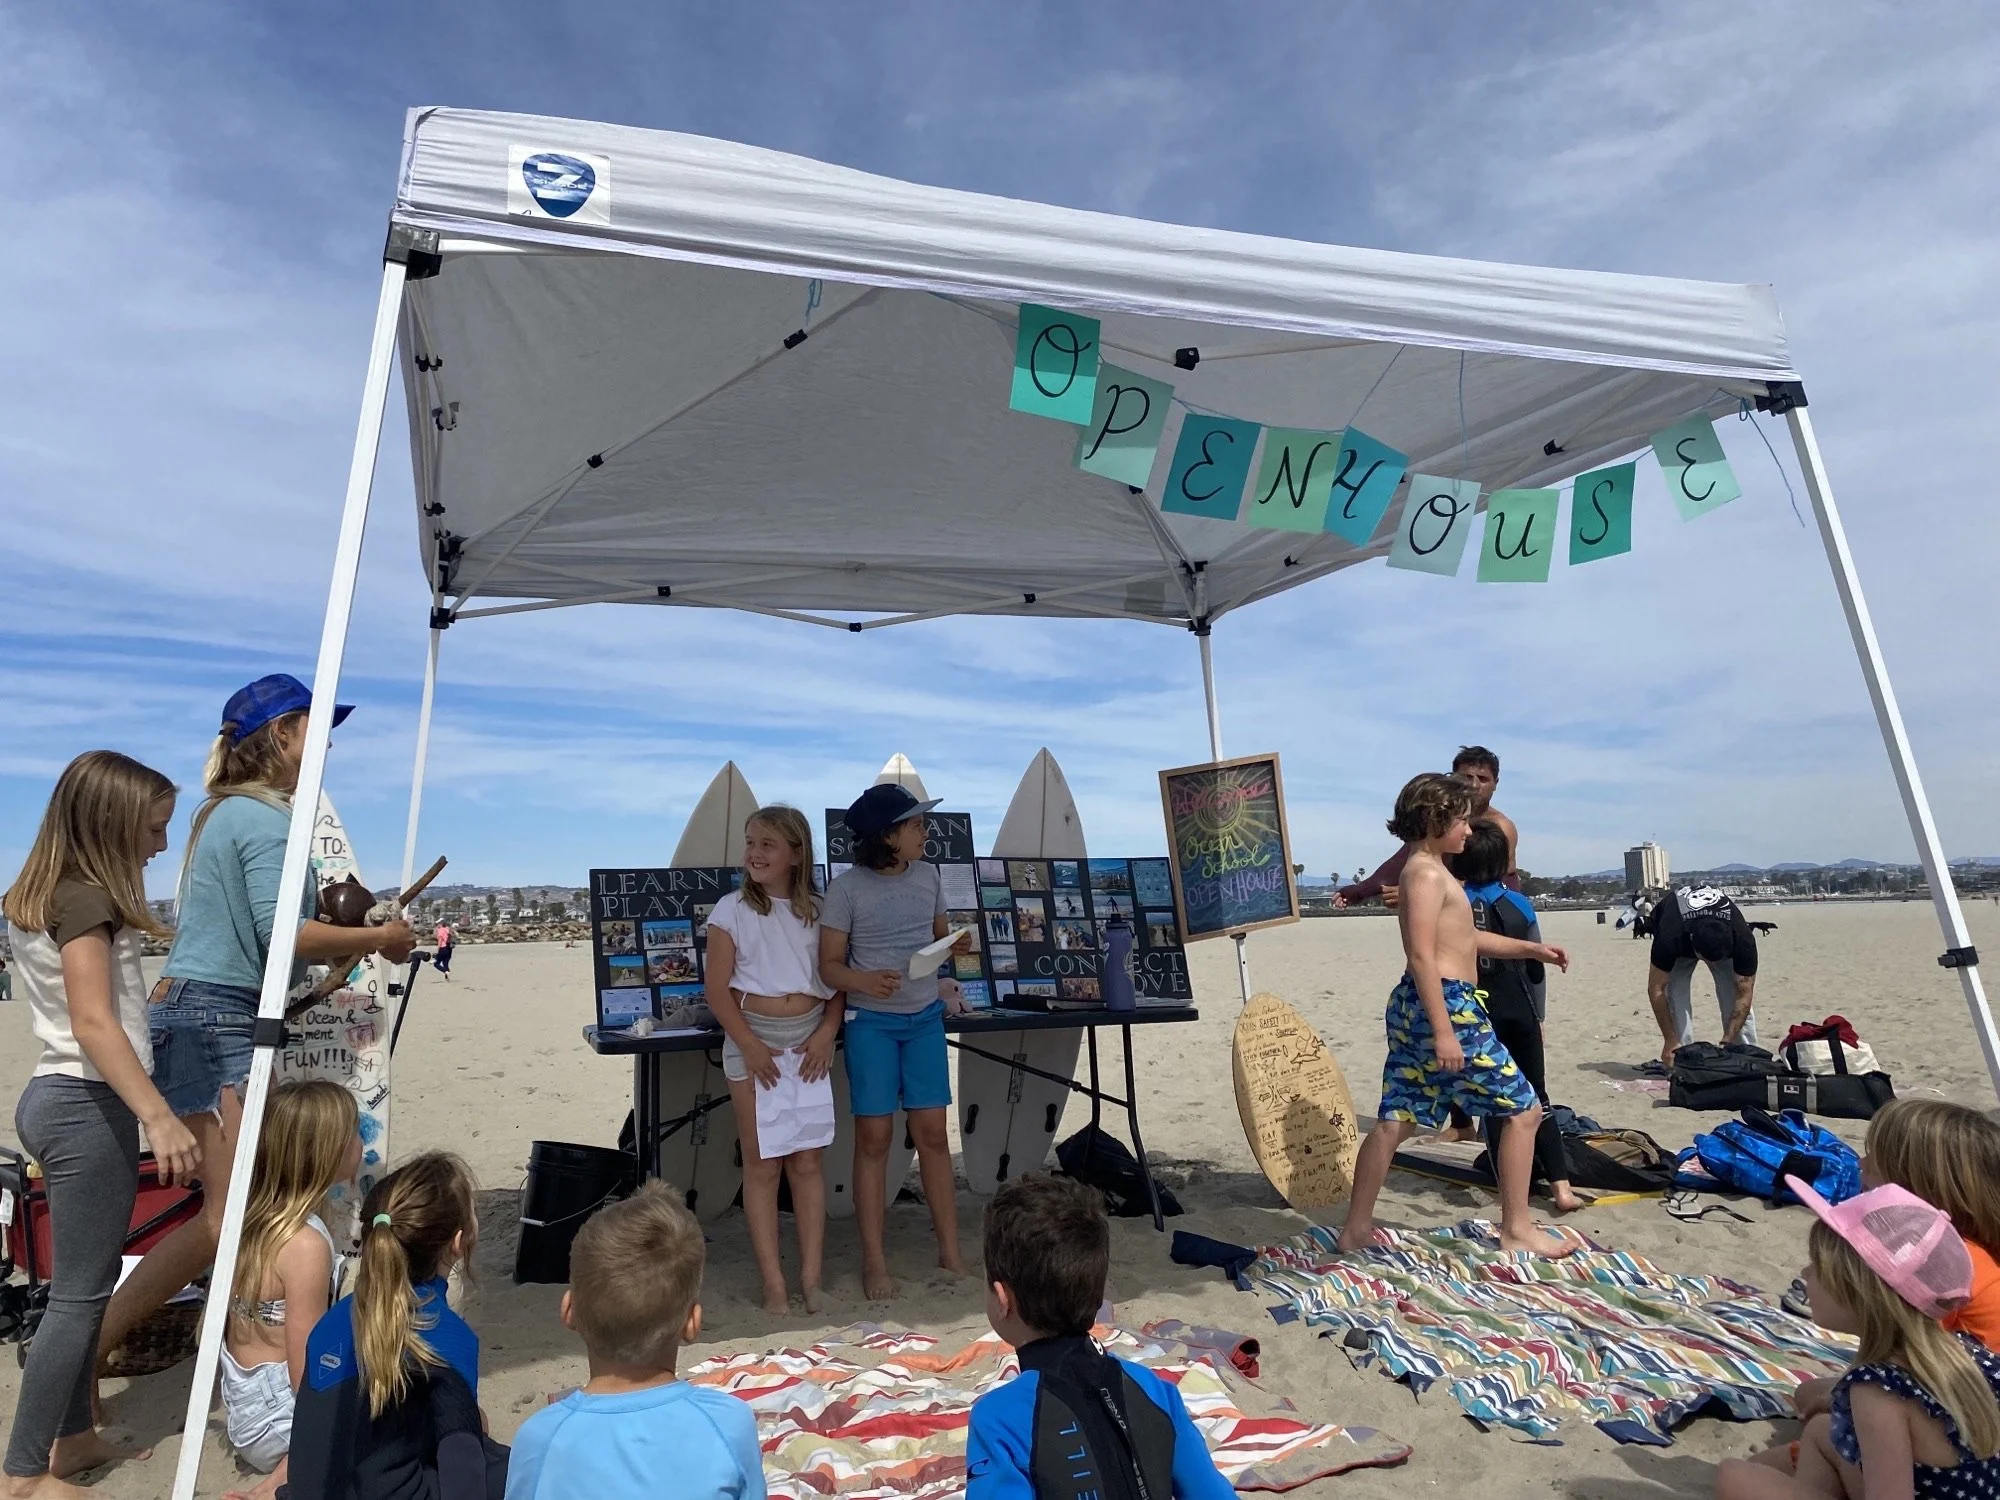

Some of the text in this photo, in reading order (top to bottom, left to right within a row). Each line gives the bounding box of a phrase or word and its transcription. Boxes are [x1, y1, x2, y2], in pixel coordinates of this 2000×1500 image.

[1030, 324, 1718, 559] OPEN HOUSE
[320, 836, 346, 855] TO:
[830, 838, 961, 860] SOL
[1186, 833, 1245, 859] Ocean
[1201, 844, 1271, 878] School
[598, 869, 720, 896] LEARN
[1186, 876, 1233, 906] OPEN
[601, 895, 690, 918] PLAY
[1133, 972, 1187, 992] OVE
[306, 1010, 342, 1025] Ocean
[346, 1009, 356, 1025] &
[283, 1049, 346, 1071] FUN!!!
